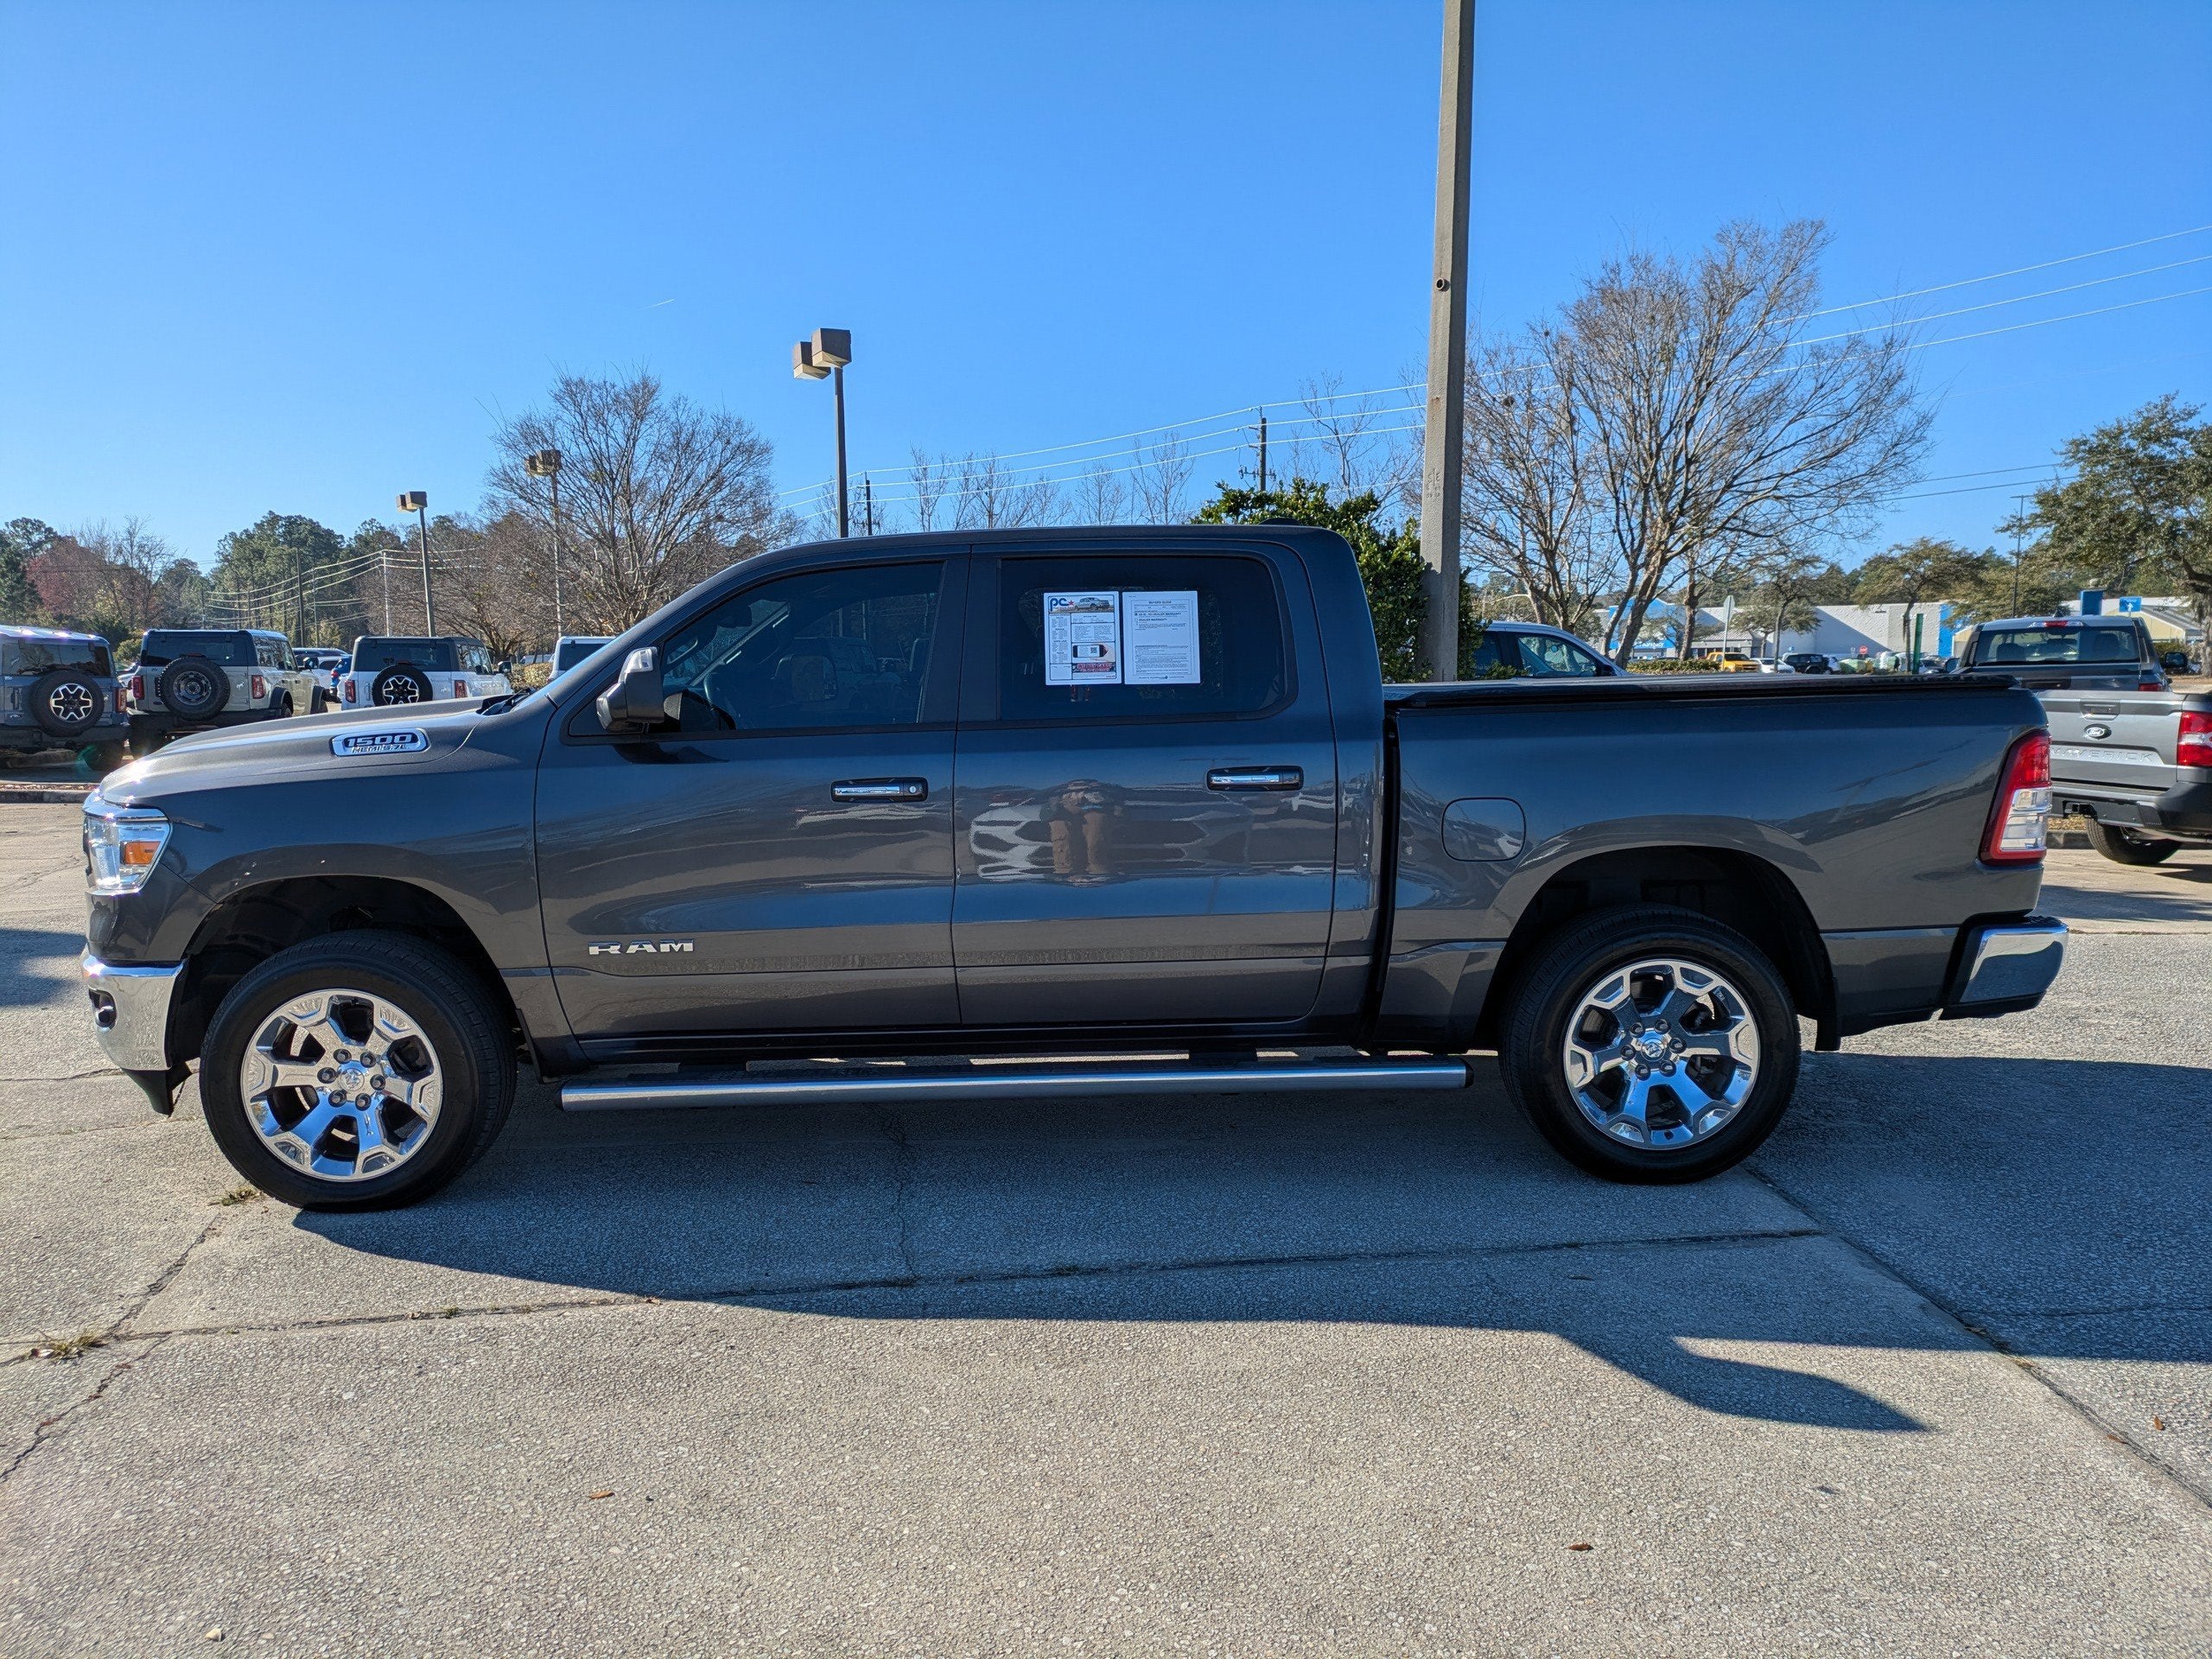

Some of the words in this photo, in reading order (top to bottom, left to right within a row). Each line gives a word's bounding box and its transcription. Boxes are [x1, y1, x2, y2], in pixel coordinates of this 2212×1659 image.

[347, 734, 412, 747] 1500
[2050, 747, 2154, 762] MAVERICK
[588, 939, 694, 955] RAM
